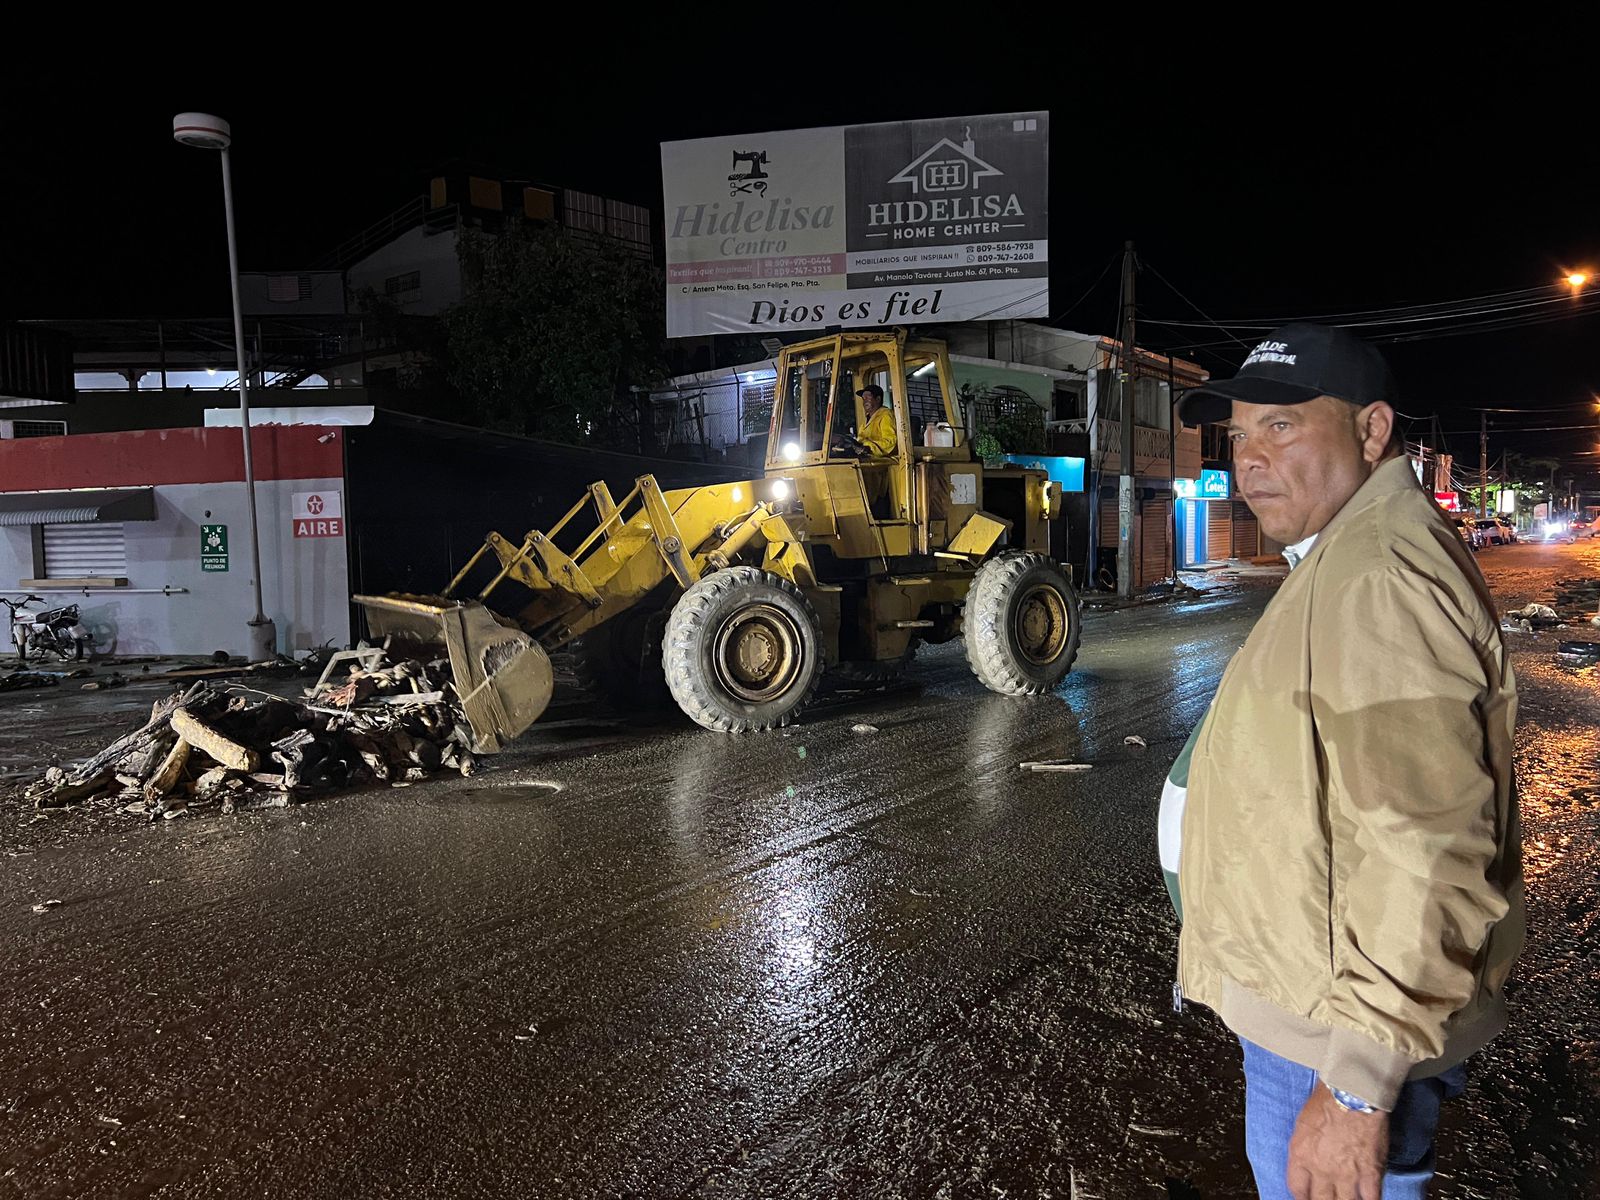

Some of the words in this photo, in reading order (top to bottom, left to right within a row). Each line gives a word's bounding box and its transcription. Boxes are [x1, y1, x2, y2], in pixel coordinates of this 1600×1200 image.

[868, 193, 1025, 226] HIDELISA
[670, 198, 835, 238] Hidelisa
[893, 226, 936, 240] HOME
[943, 222, 1000, 237] CENTER
[720, 237, 787, 257] Centro
[976, 242, 1034, 253] 809-586-7938
[855, 256, 900, 266] MOBILIARIOS
[920, 253, 953, 261] INSPIRAN
[977, 253, 1034, 263] 809-747-2608
[670, 268, 698, 278] Textiles
[699, 268, 715, 278] que
[874, 275, 885, 283] Av.
[886, 272, 913, 281] Manolo
[944, 270, 964, 278] Justo
[1005, 266, 1020, 274] Pta.
[692, 286, 715, 294] Antera
[752, 282, 766, 290] San
[748, 299, 825, 325] Dios
[838, 300, 871, 322] es
[878, 289, 943, 324] fiel
[297, 521, 339, 535] AIRE
